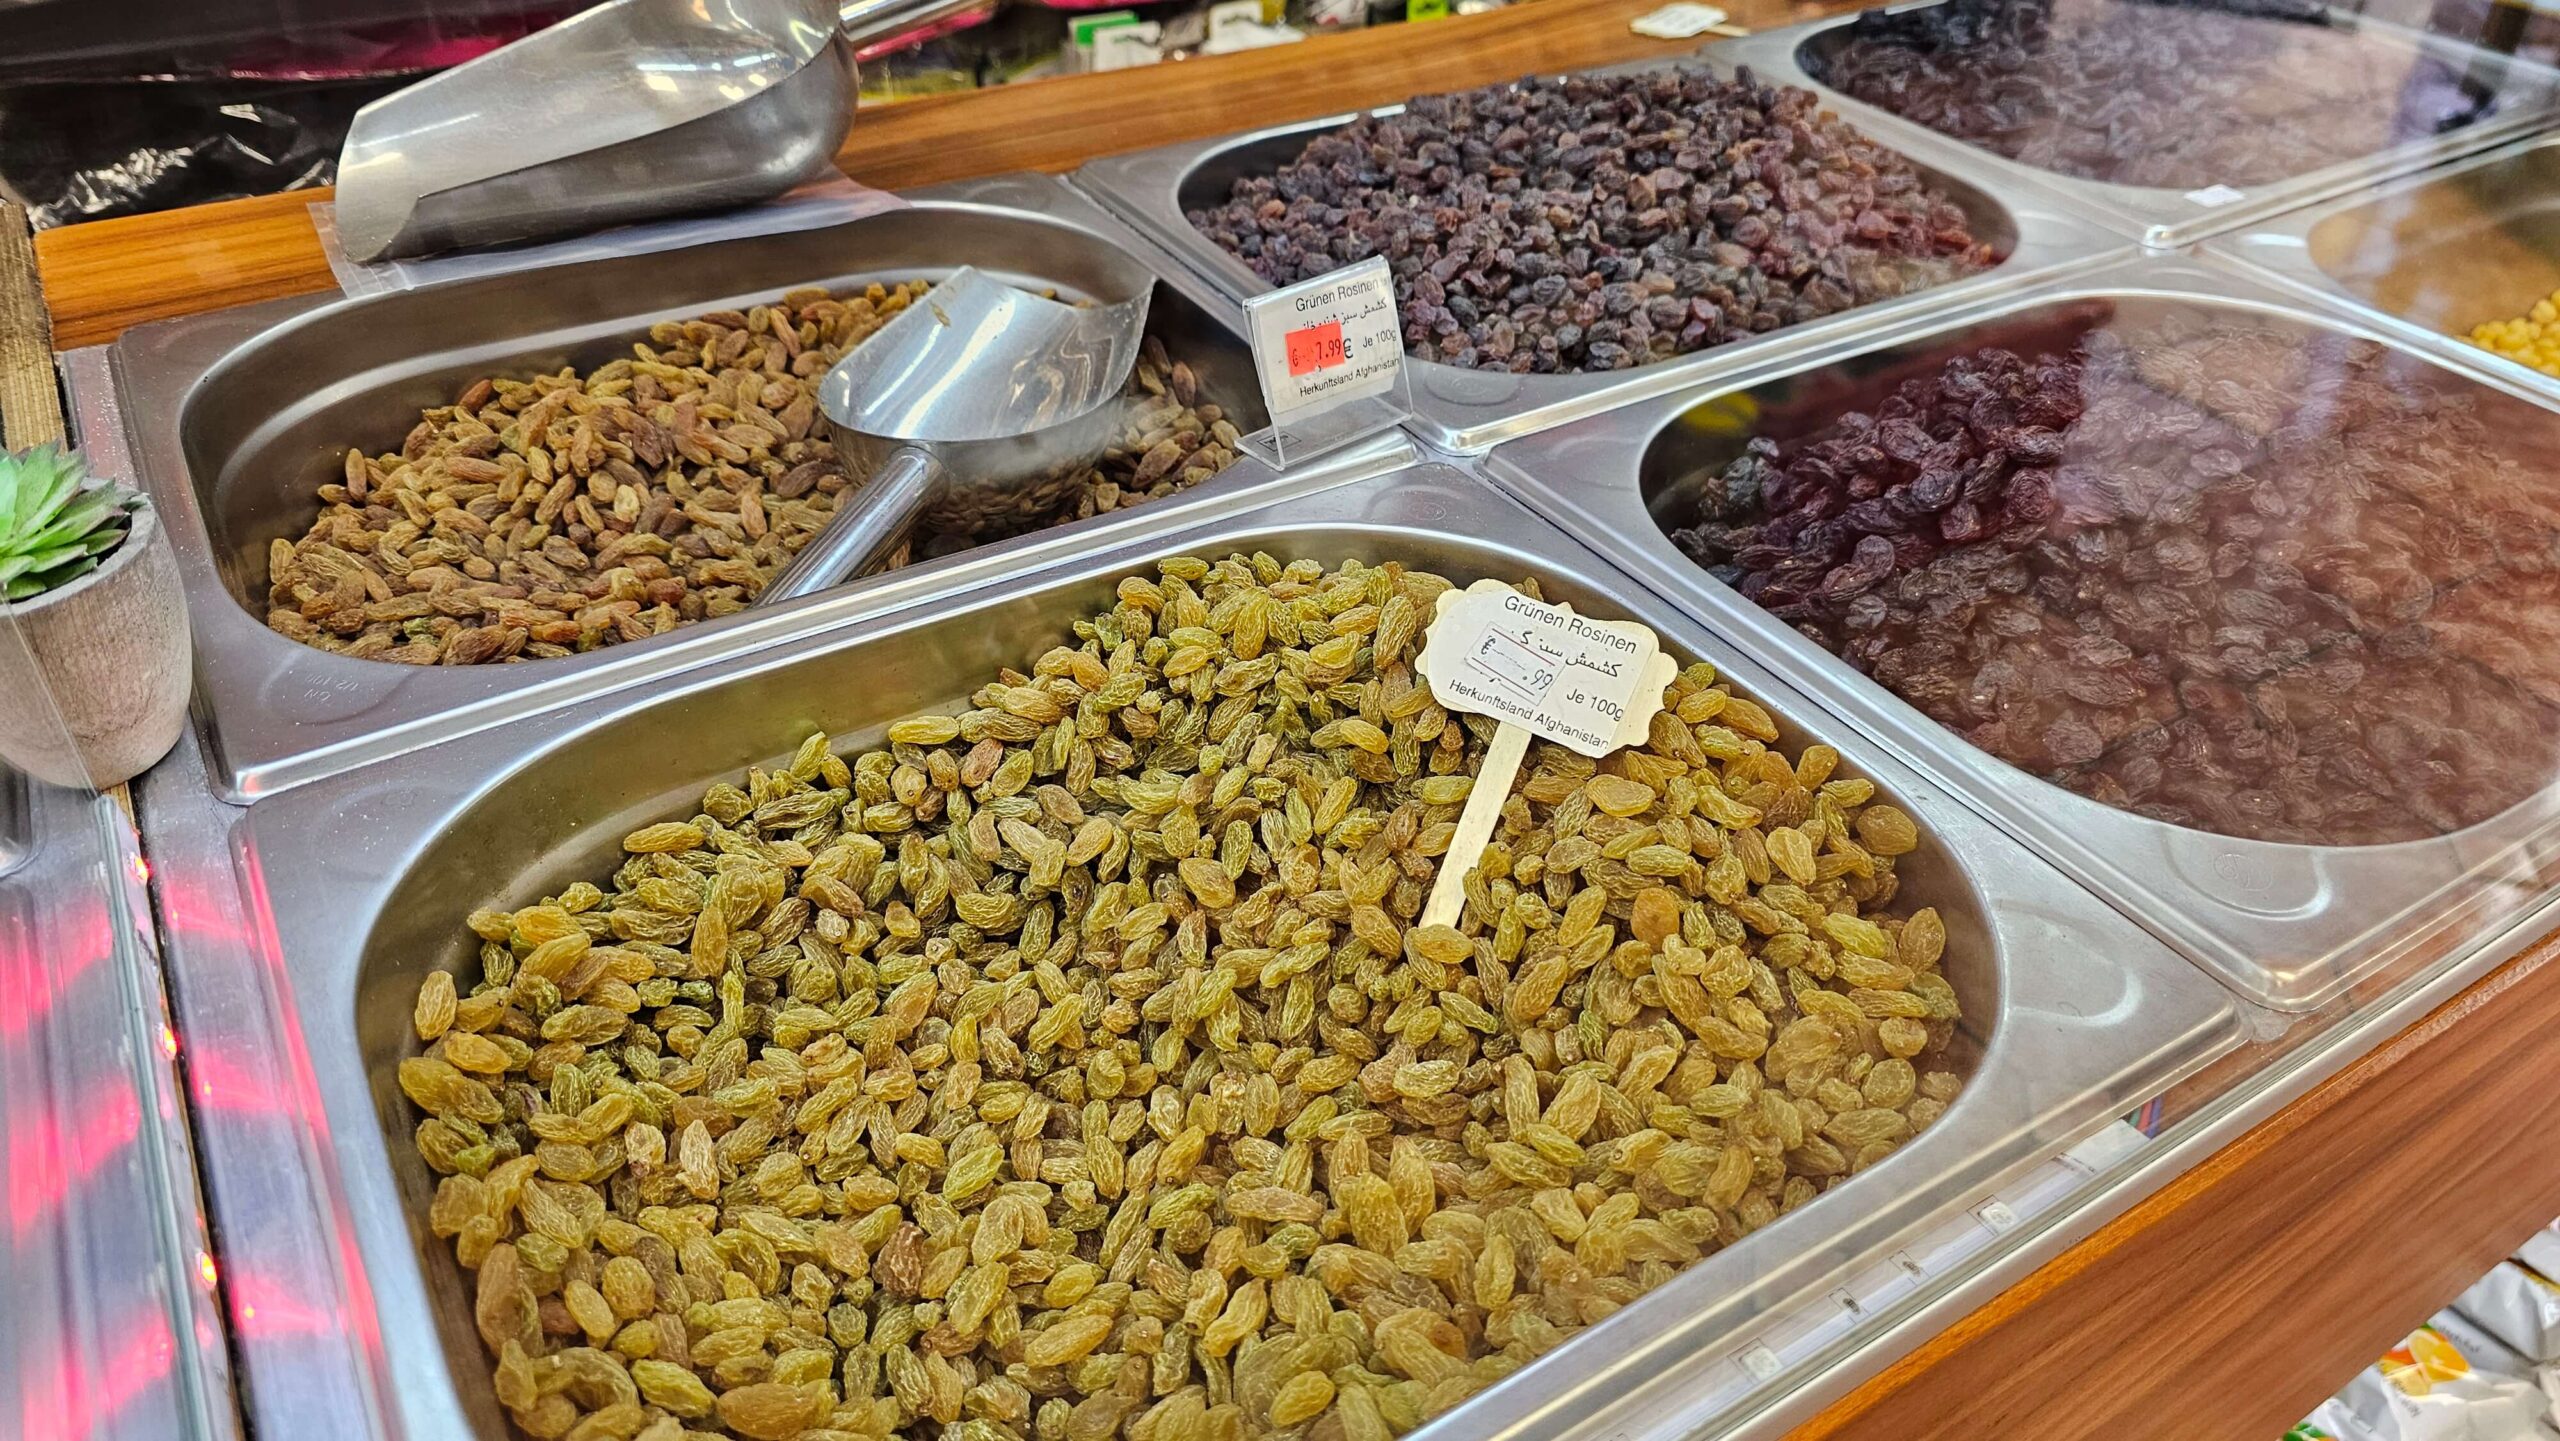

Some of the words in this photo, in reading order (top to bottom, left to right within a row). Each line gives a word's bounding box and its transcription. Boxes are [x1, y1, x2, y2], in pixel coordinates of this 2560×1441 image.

[1296, 291, 1336, 312] Grünen
[1337, 279, 1379, 301] Rosinen
[1343, 338, 1354, 359] €
[1362, 336, 1373, 349] Je
[1376, 328, 1397, 344] 100g
[1299, 371, 1354, 397] Herkunftsland
[1355, 357, 1400, 379] Afghanistan
[1504, 596, 1564, 628] Grünen
[1567, 617, 1637, 654] Rosinen
[1449, 679, 1534, 721] Herkunftsland
[1534, 713, 1609, 750] Afghanistan
[1566, 688, 1585, 704] Je
[1590, 696, 1624, 722] 100g
